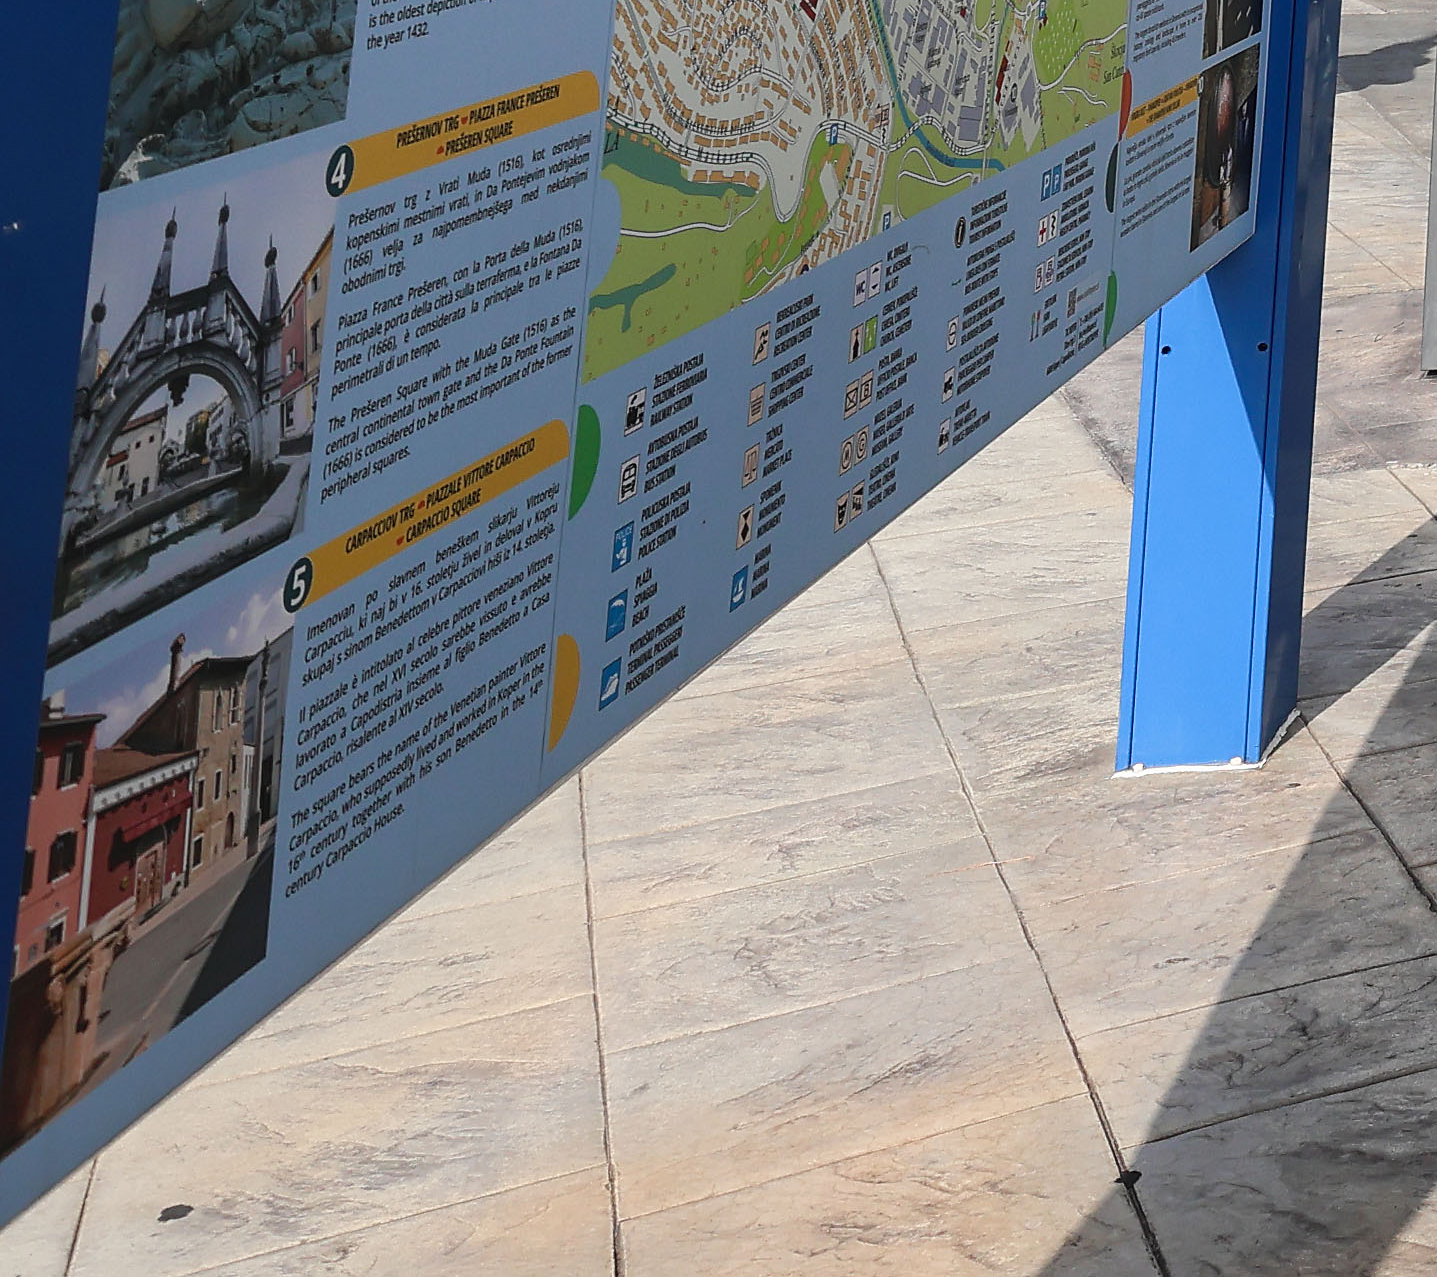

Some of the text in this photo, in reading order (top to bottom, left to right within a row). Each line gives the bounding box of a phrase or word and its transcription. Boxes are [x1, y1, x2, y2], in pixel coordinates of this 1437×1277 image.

[395, 83, 560, 149] PREŠERNOV TRG PIAZZA FRANCE PREŠEREN
[444, 119, 514, 156] PREŠEREN SQUARE
[344, 437, 535, 554] CARPACCIOV TRG PIAZZALE VITTORE CARPACCIO
[405, 487, 482, 543] CARPACCIO SQUARE
